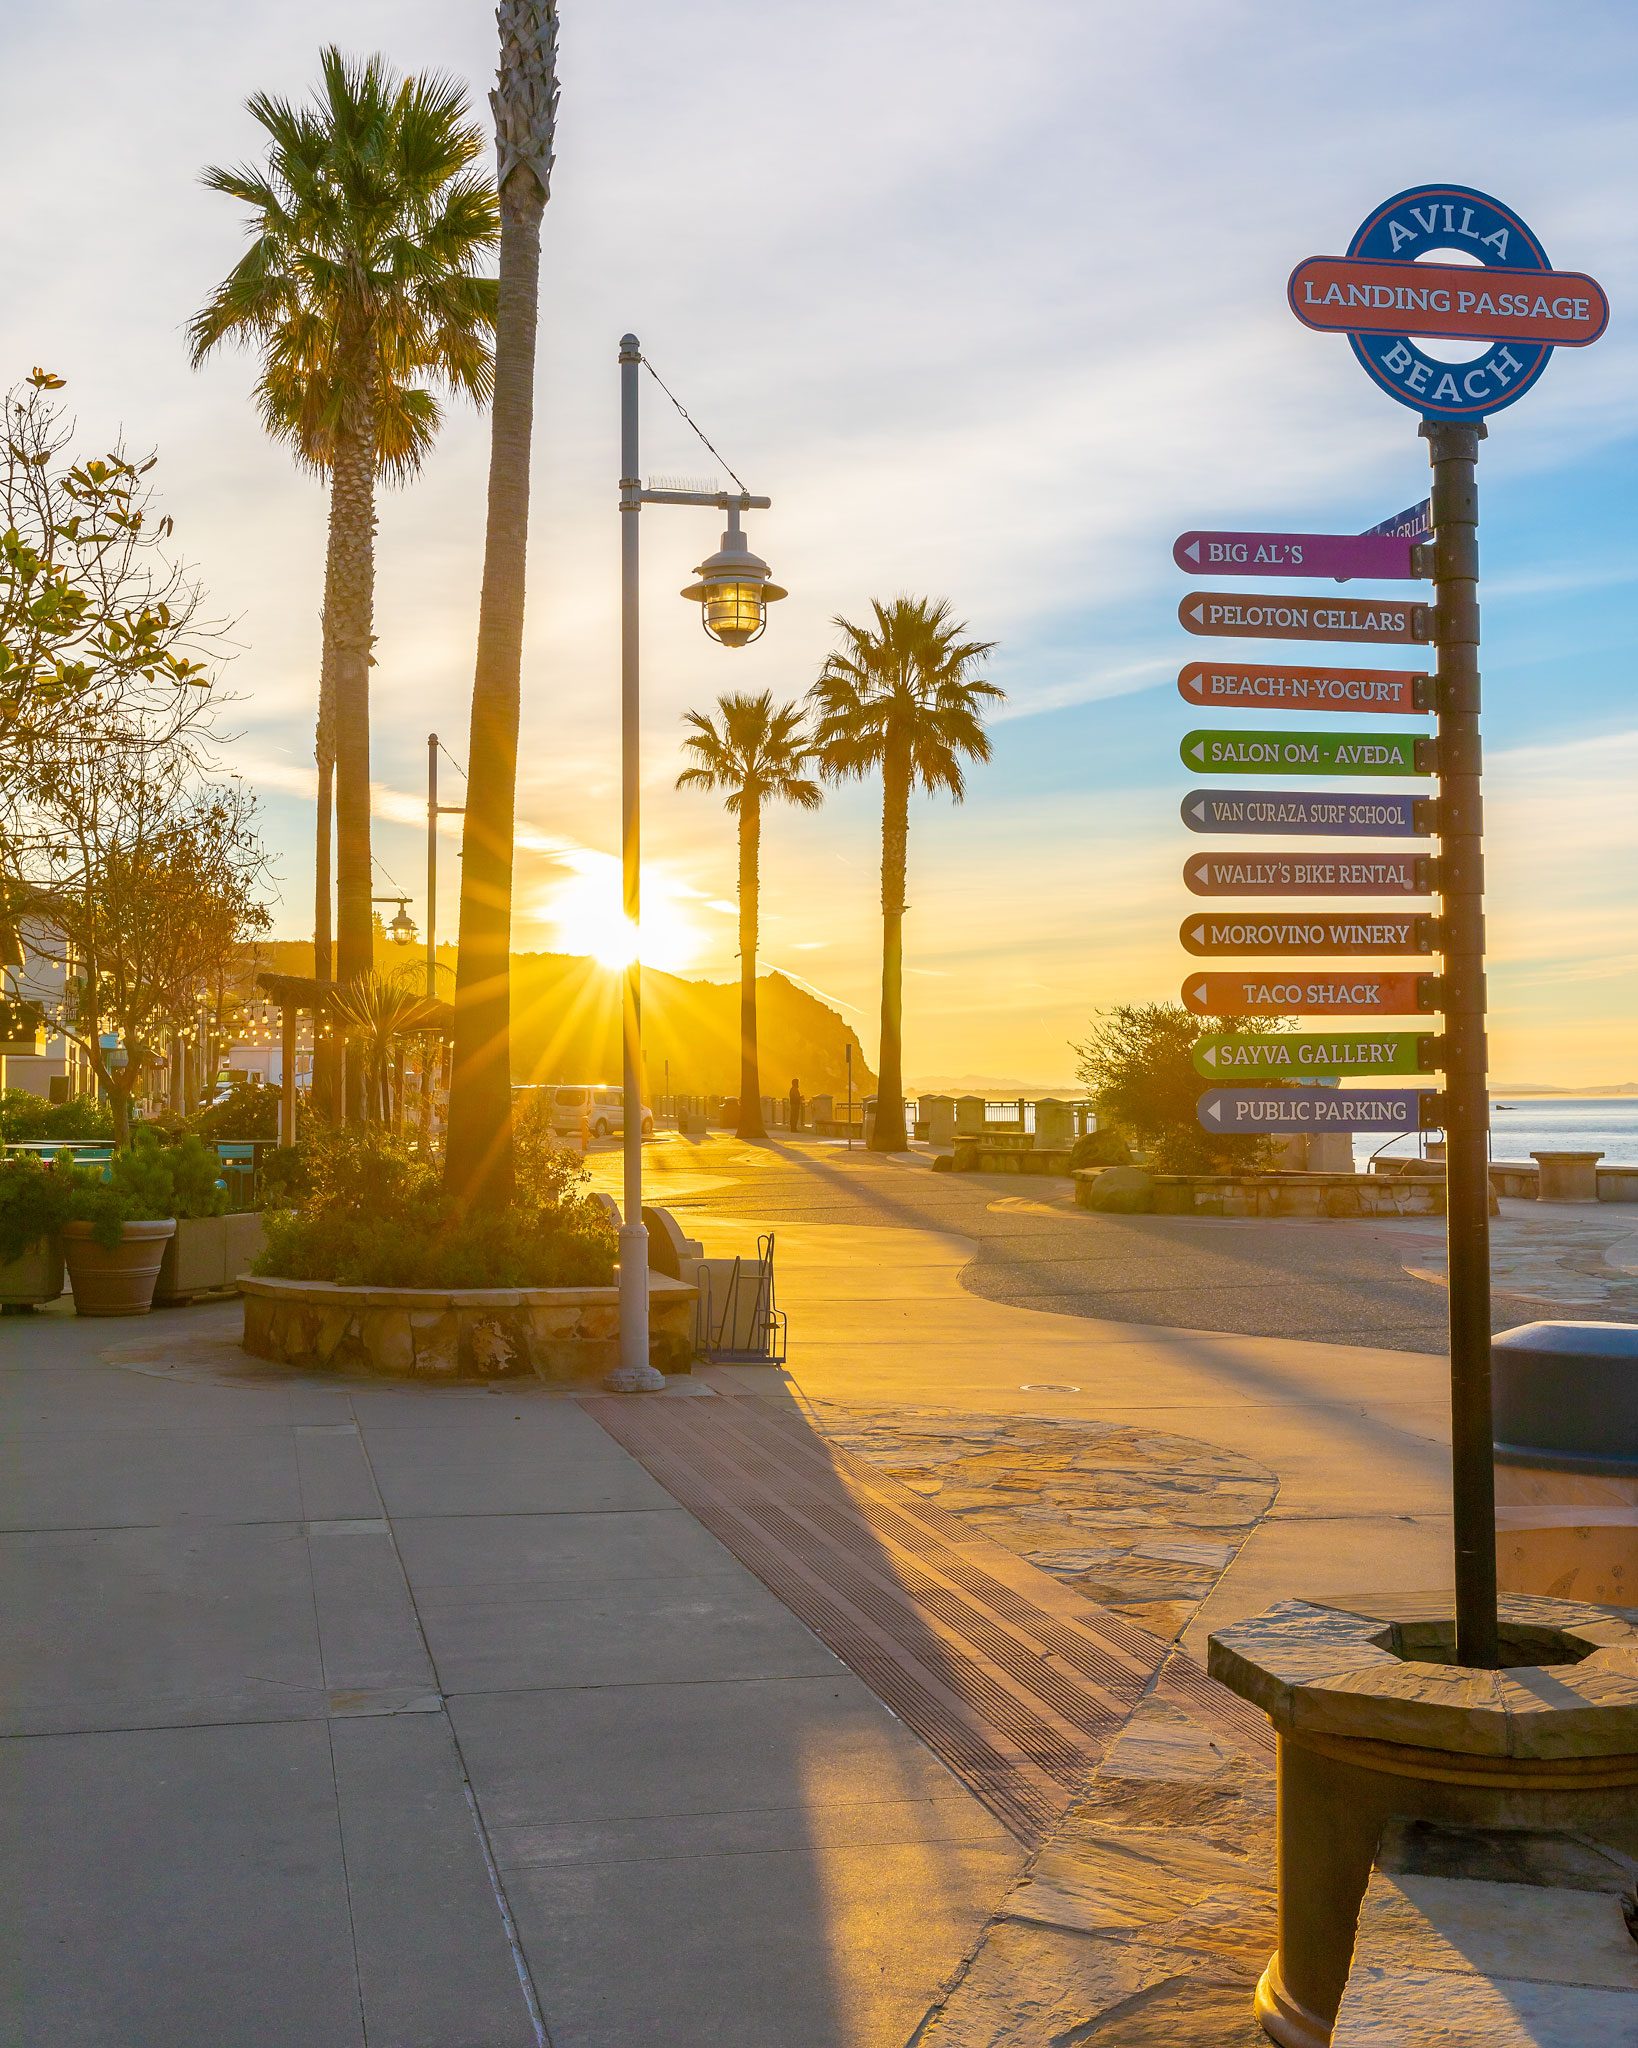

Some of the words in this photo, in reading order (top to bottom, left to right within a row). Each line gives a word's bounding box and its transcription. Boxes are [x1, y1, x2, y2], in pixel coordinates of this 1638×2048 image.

[1387, 203, 1510, 260] AVILA
[1304, 281, 1451, 312] LANDING
[1457, 290, 1591, 321] PASSAGE
[1380, 340, 1523, 403] BEACH
[1396, 513, 1429, 538] GRILL
[1208, 543, 1249, 563] BIG
[1253, 545, 1304, 564] AL'S
[1209, 605, 1309, 628] PELOTON
[1313, 610, 1406, 632] CELLARS
[1210, 675, 1404, 702] BEACH-N-YOGURT
[1211, 742, 1280, 763] SALON
[1284, 744, 1319, 764] OM
[1334, 745, 1405, 766] AVEDA
[1212, 802, 1244, 822] VAN
[1246, 803, 1308, 823] CURAZA
[1310, 804, 1347, 825] SURF
[1349, 805, 1406, 826] SCHOOL
[1213, 862, 1291, 885] WALLY'S
[1294, 865, 1335, 885] BIKE
[1339, 865, 1409, 886] RENTAL
[1211, 925, 1325, 946] MOROVINO
[1328, 925, 1409, 945] WINERY
[1243, 984, 1302, 1005] TACO
[1306, 984, 1381, 1005] SHACK
[1220, 1044, 1292, 1066] SAYVA
[1298, 1043, 1398, 1065] GALLERY
[1235, 1101, 1310, 1122] PUBLIC
[1313, 1101, 1407, 1122] PARKING
